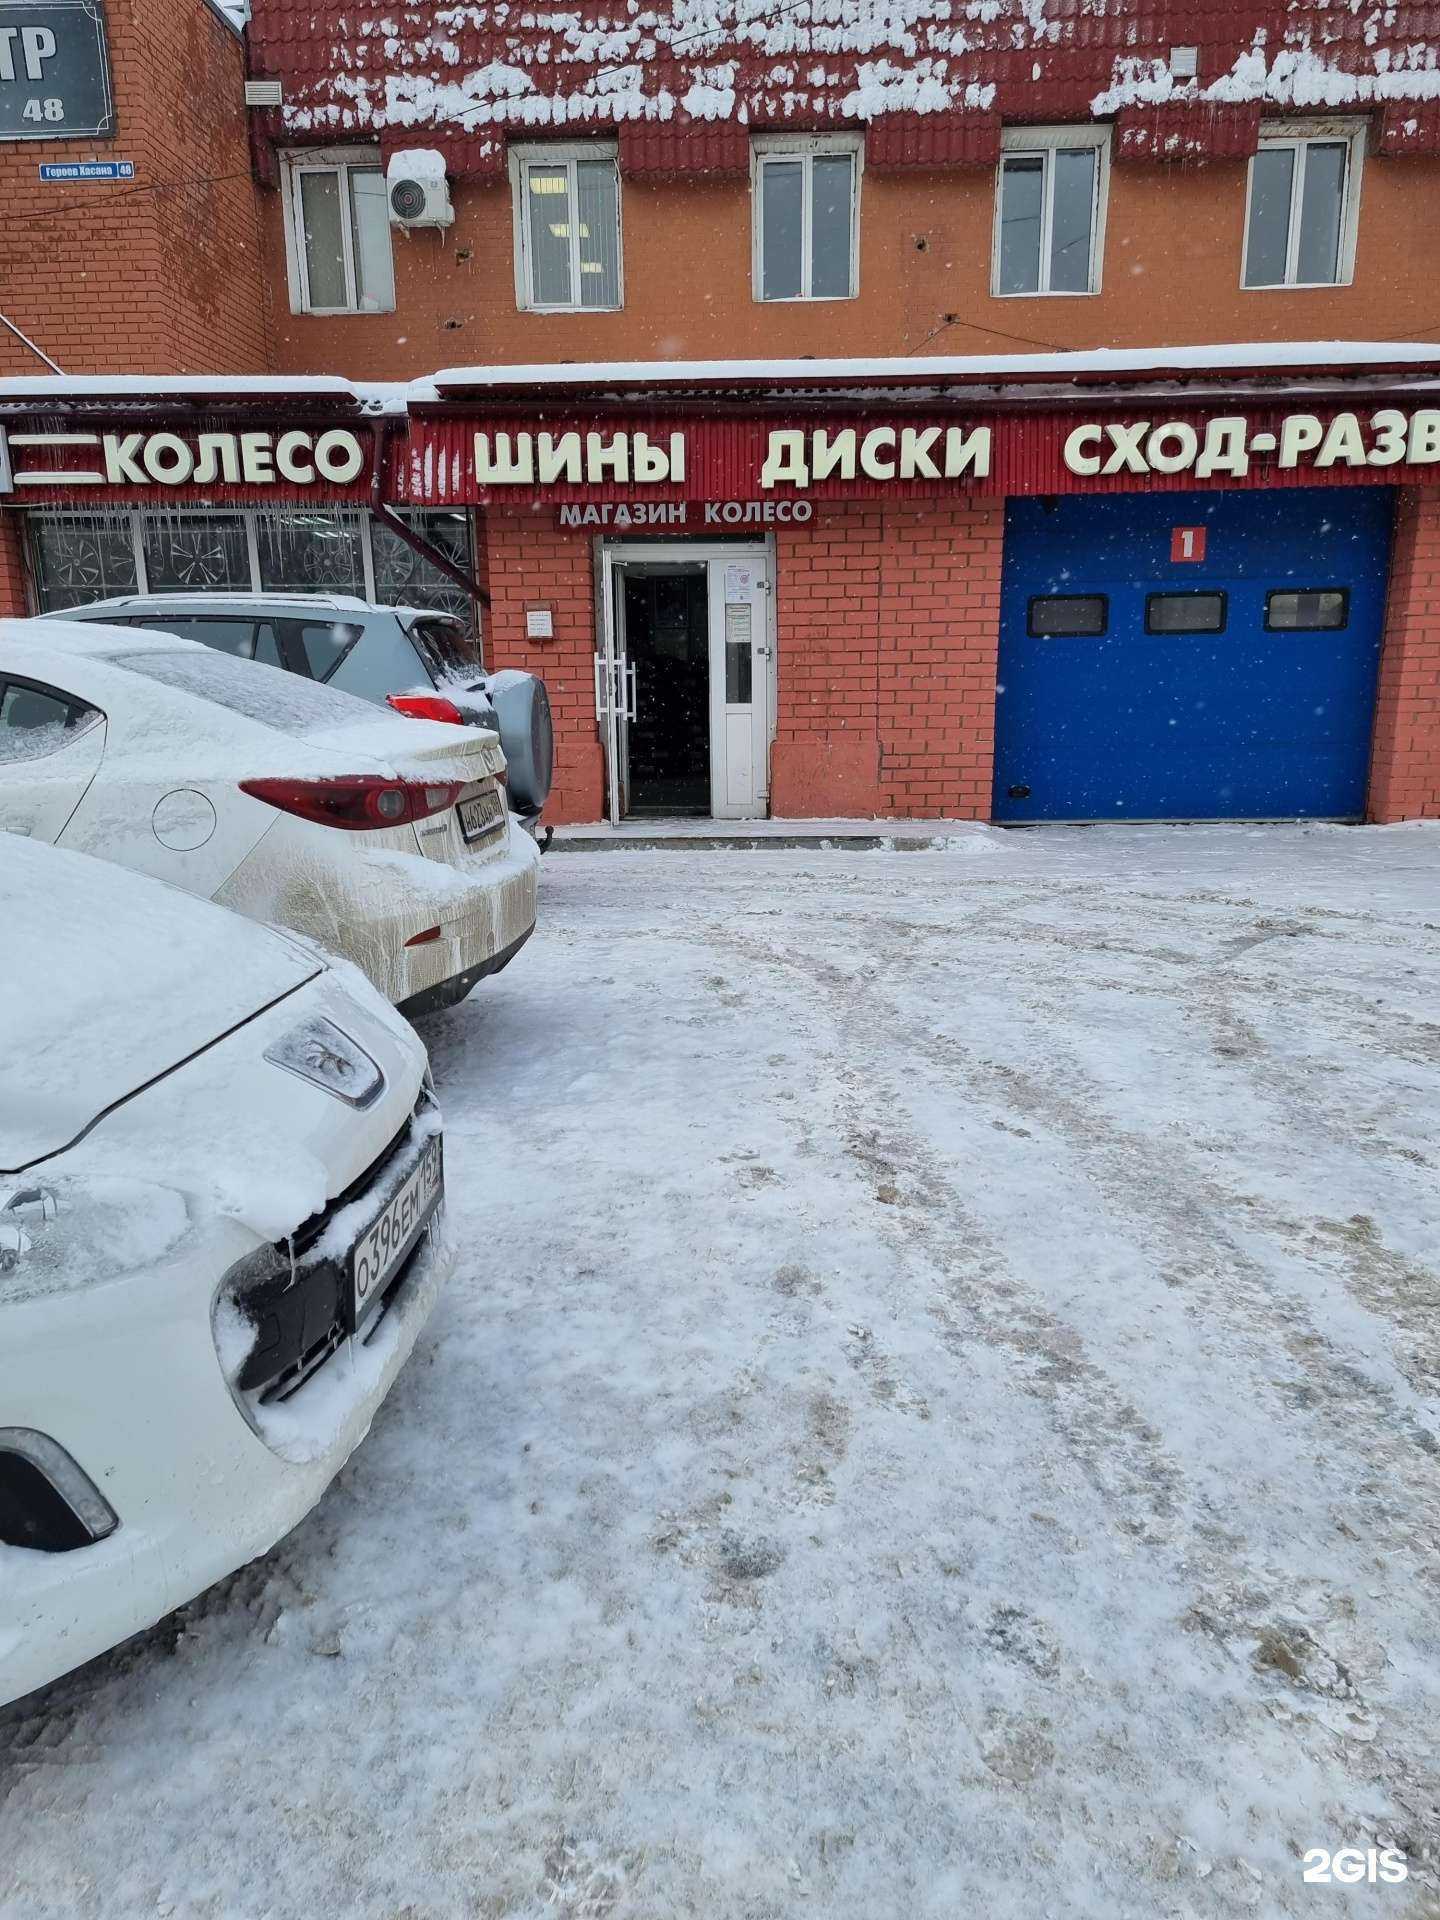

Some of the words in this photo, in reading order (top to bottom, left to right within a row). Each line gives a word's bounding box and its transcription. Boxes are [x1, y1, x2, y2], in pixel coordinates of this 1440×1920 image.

[22, 98, 65, 122] 48
[45, 166, 79, 178] Героев
[79, 165, 113, 176] Хасана
[119, 164, 132, 175] 48
[102, 429, 364, 486] КОЛЕСО
[474, 431, 686, 486] ШИНЫ
[761, 426, 992, 489] ДИСКИ
[559, 502, 687, 526] МАГАЗИН
[704, 500, 813, 524] КОЛЕСО
[1181, 530, 1195, 558] 1
